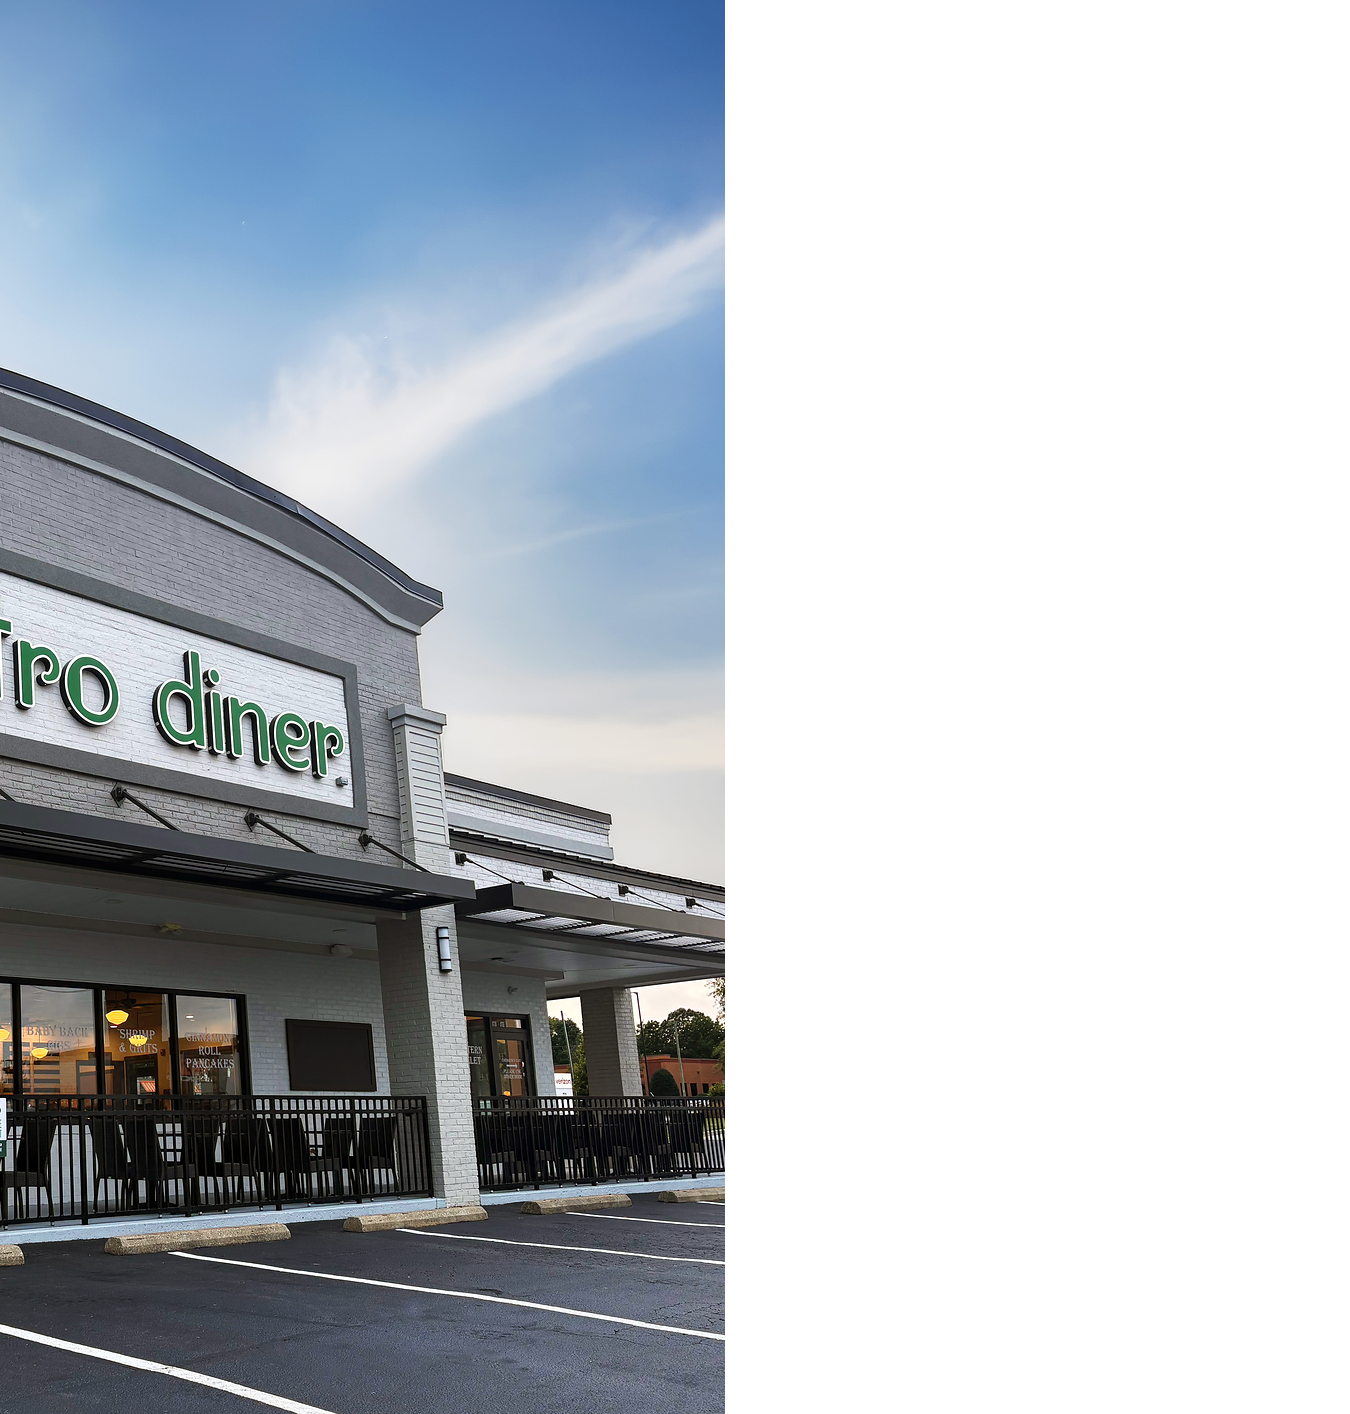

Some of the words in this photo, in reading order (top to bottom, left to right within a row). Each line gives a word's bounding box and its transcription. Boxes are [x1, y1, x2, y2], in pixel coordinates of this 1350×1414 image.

[152, 650, 345, 779] diner
[26, 1025, 56, 1036] BABY
[59, 1026, 89, 1037] BACK
[119, 1028, 155, 1039] SHRIMP
[185, 1032, 231, 1043] CINNAMON
[47, 1040, 71, 1050] RIBS
[119, 1042, 126, 1052] &
[129, 1043, 158, 1053] GRITS
[198, 1045, 221, 1056] ROLL
[186, 1058, 234, 1068] PANCAKES
